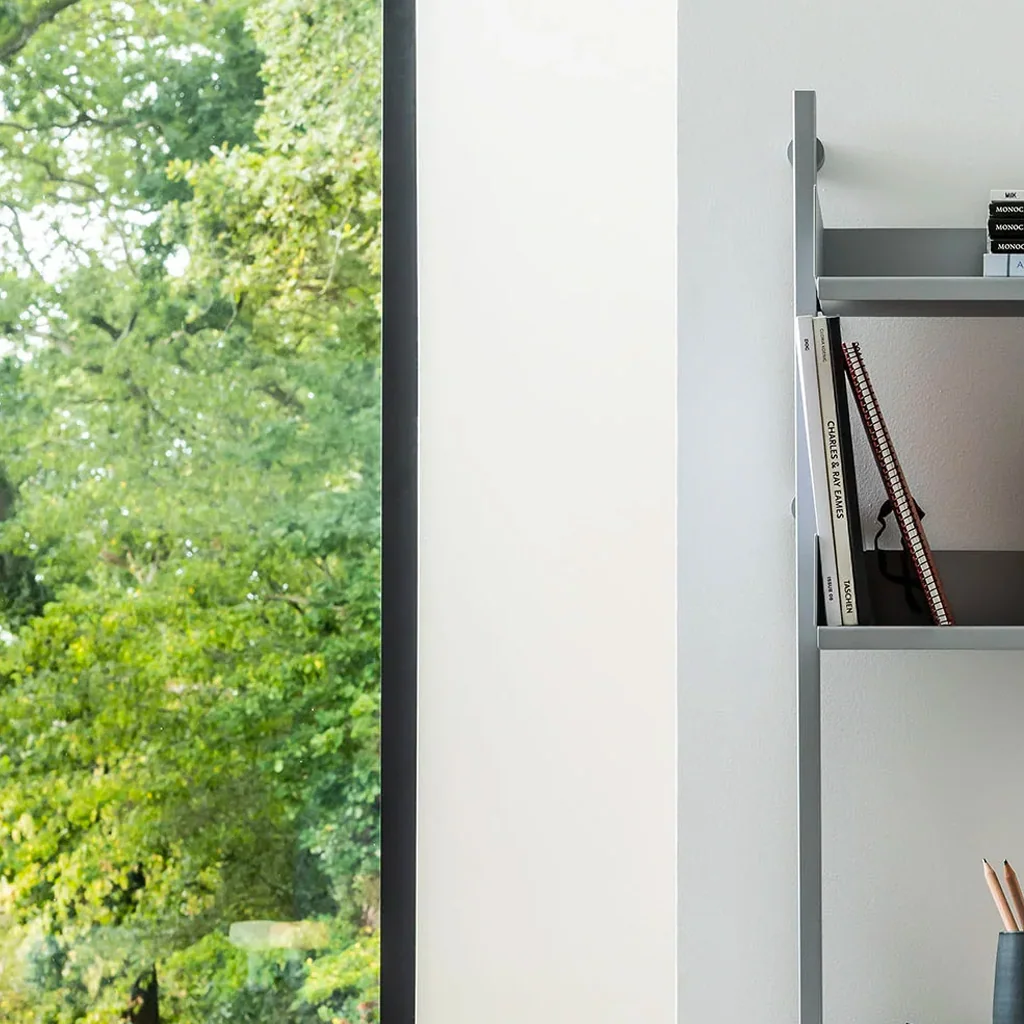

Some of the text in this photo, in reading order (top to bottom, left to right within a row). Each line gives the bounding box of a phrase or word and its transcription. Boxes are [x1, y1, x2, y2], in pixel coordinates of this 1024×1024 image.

[827, 420, 844, 520] CHARLES & RAY EAMES
[844, 580, 853, 614] TASCHEN
